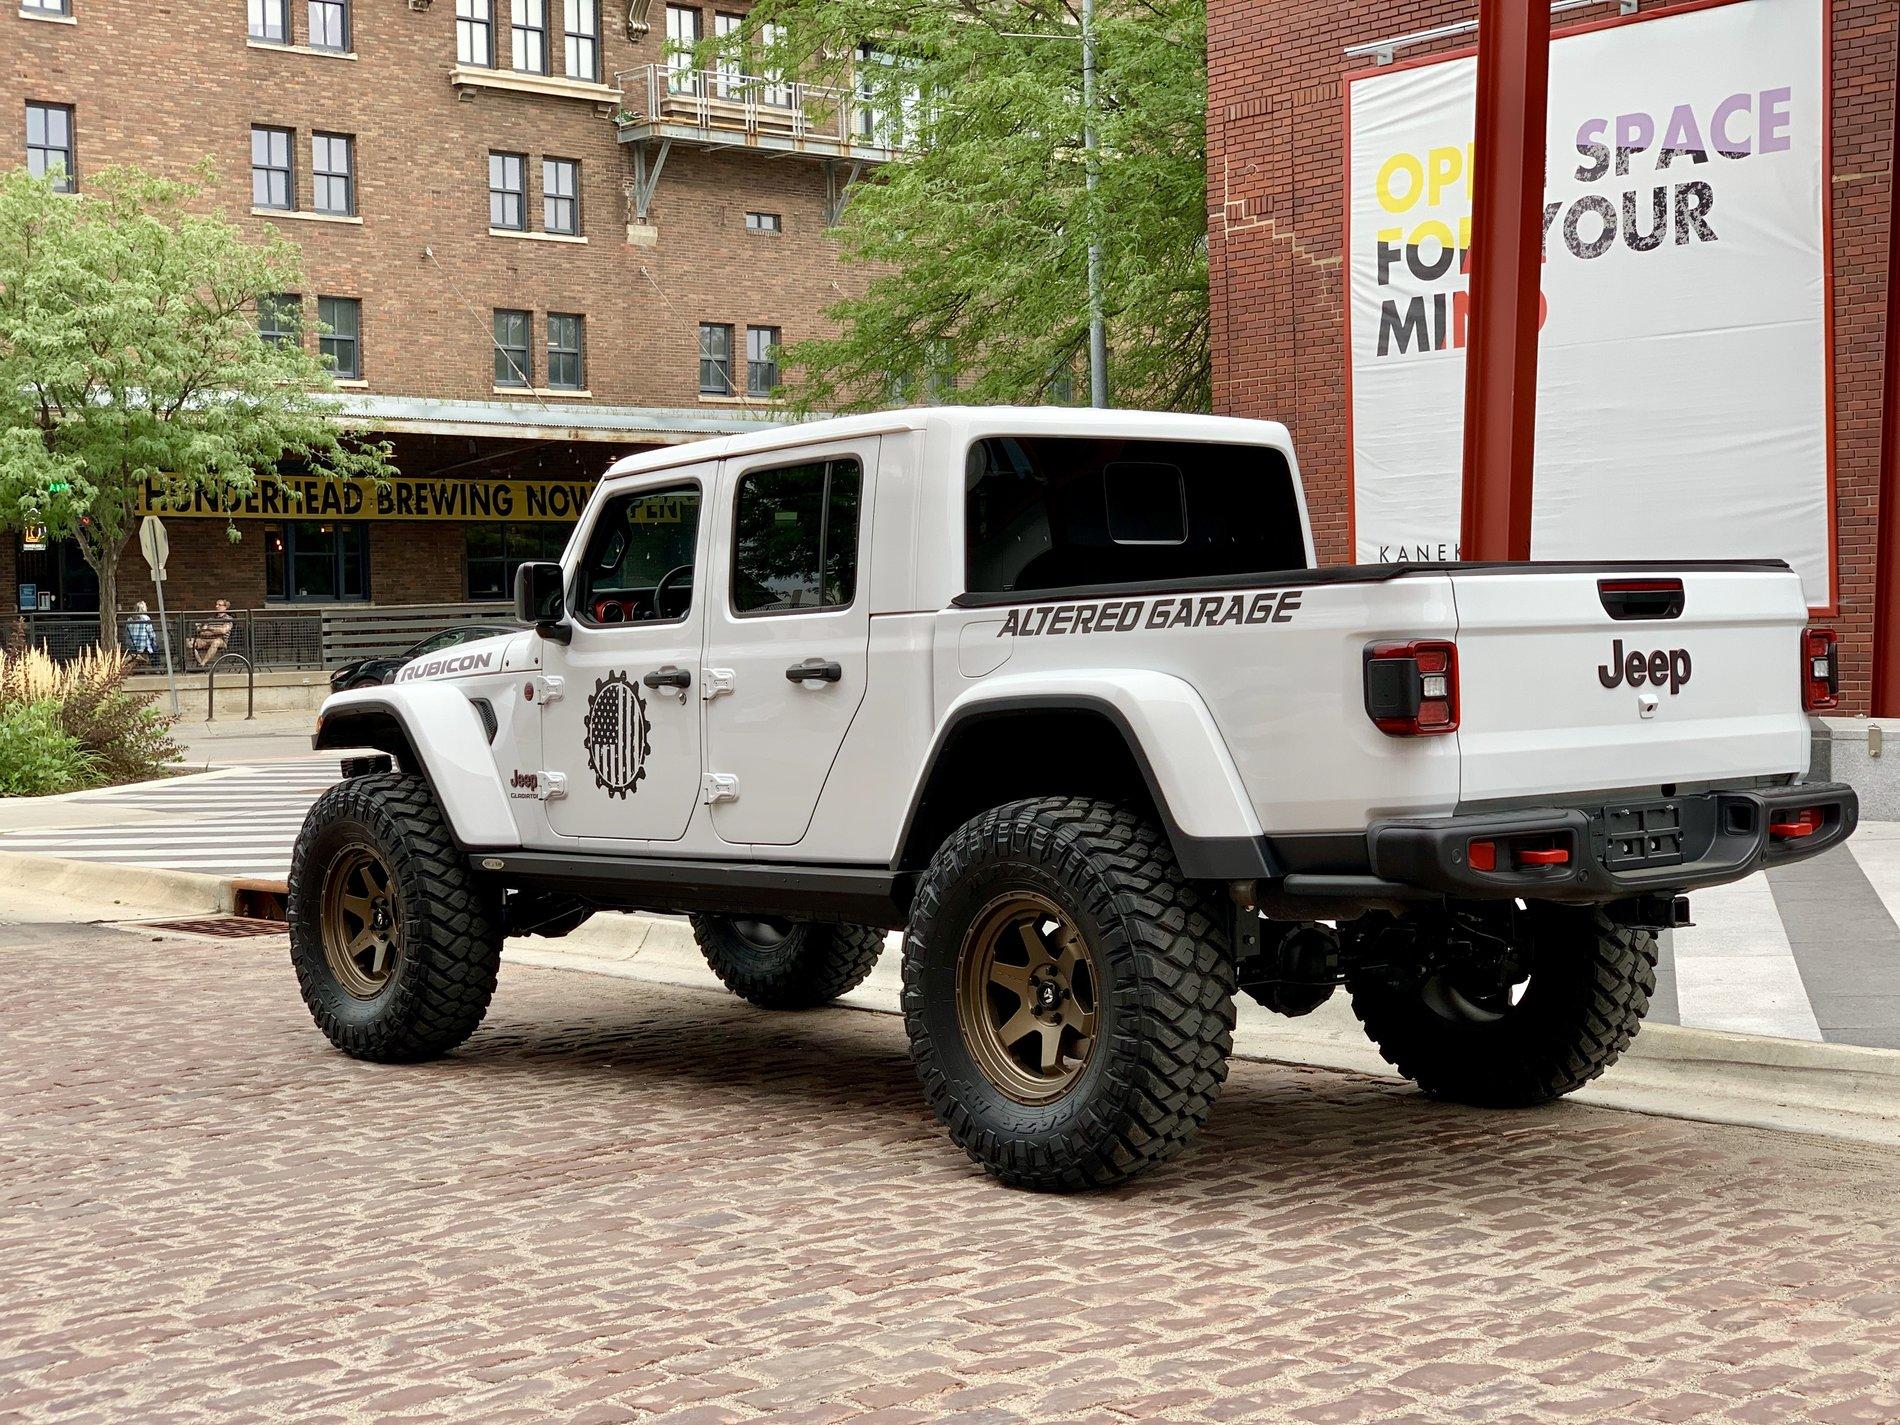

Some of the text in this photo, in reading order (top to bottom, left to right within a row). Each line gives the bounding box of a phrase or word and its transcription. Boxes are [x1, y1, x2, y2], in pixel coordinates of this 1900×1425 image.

[1574, 86, 1791, 183] SPACE
[134, 476, 363, 516] HUNDERHEAD
[377, 482, 514, 517] BREWING
[996, 590, 1303, 638] ALTERED GARAGE
[400, 652, 493, 682] RUBICON
[1598, 639, 1692, 695] Jeep
[510, 769, 538, 791] Jeep
